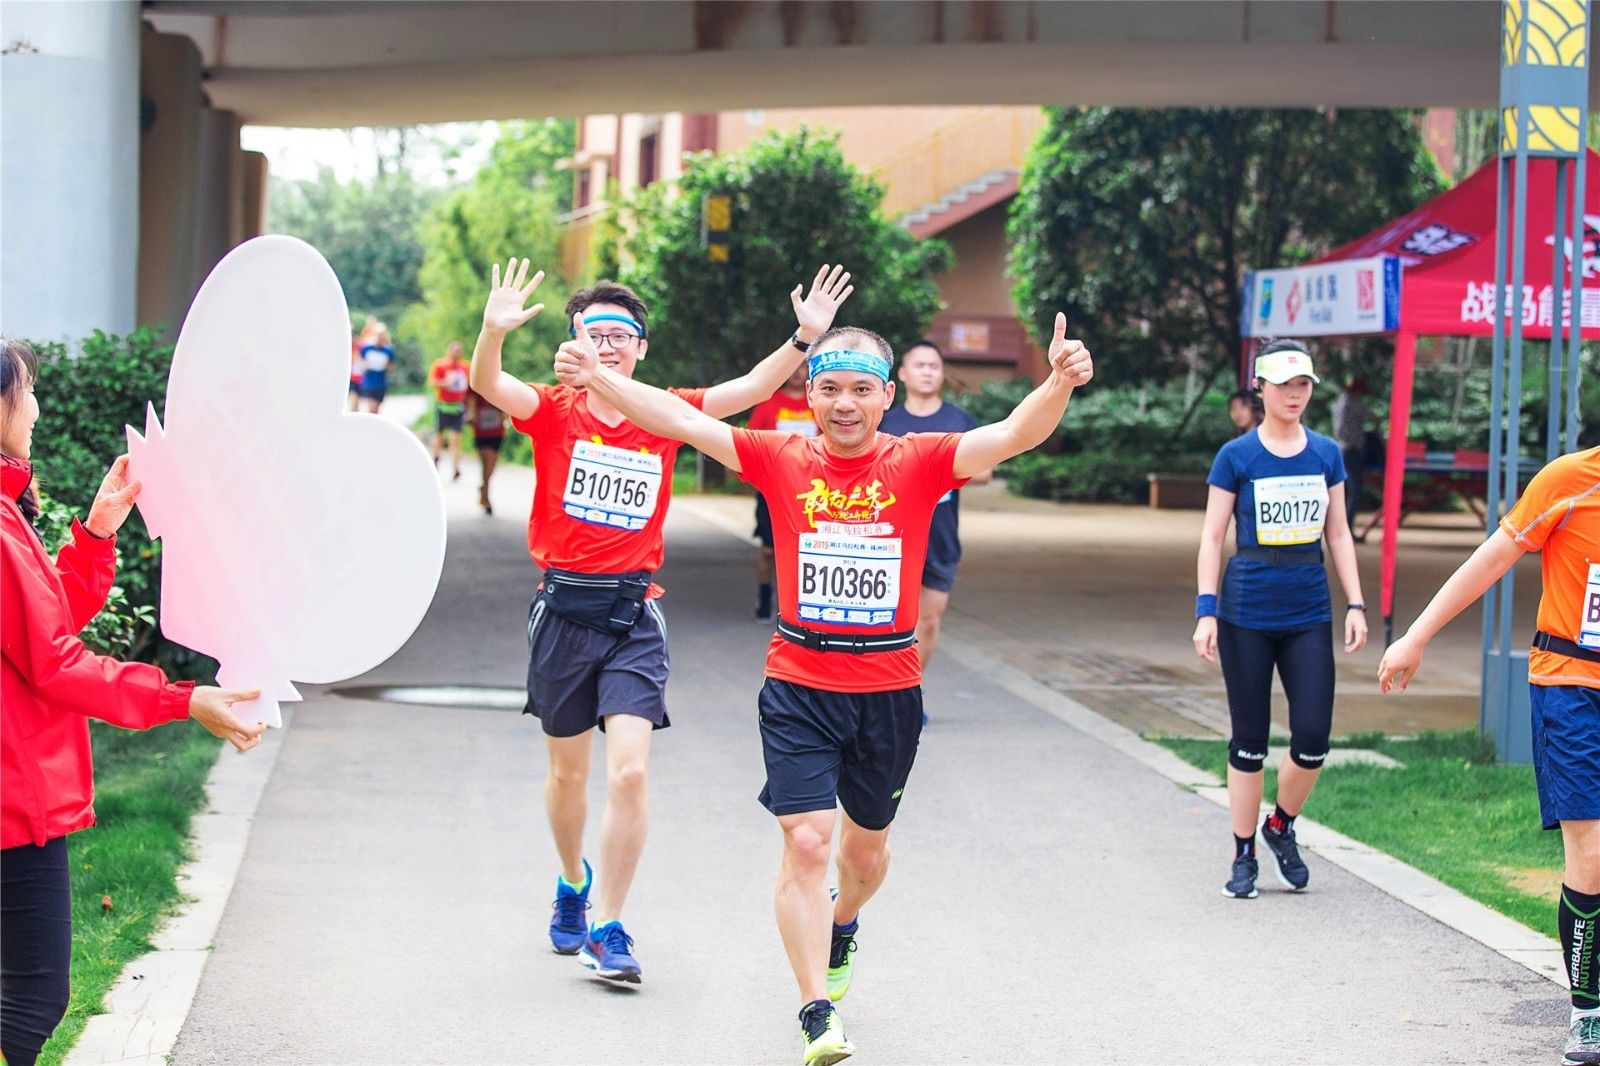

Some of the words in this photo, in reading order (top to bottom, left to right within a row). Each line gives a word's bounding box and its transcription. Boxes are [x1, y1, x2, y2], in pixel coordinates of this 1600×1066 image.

[571, 467, 648, 507] B10156
[1260, 500, 1320, 523] B20172
[802, 562, 887, 600] B10366
[1571, 918, 1586, 988] HERBALIFE
[1580, 919, 1595, 989] NUTRITION
